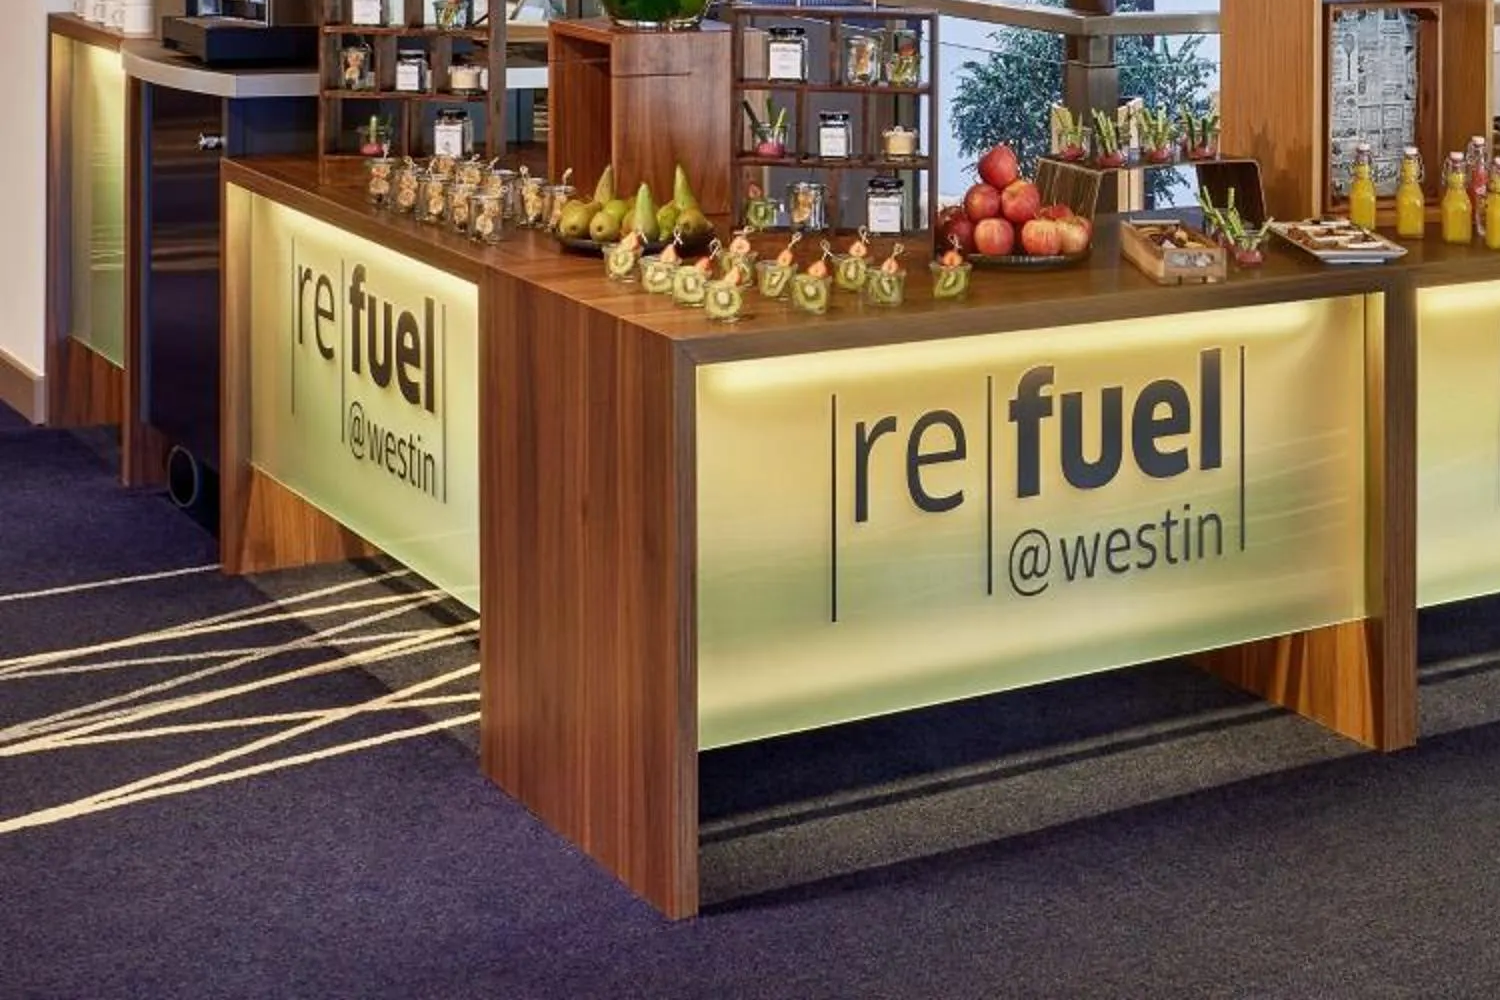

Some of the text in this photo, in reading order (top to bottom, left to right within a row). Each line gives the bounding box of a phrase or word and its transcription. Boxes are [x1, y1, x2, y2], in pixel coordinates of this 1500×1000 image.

[298, 263, 436, 413] re fuel
[349, 400, 436, 498] @westin
[854, 347, 1222, 523] re fuel
[1008, 503, 1223, 597] @westin
